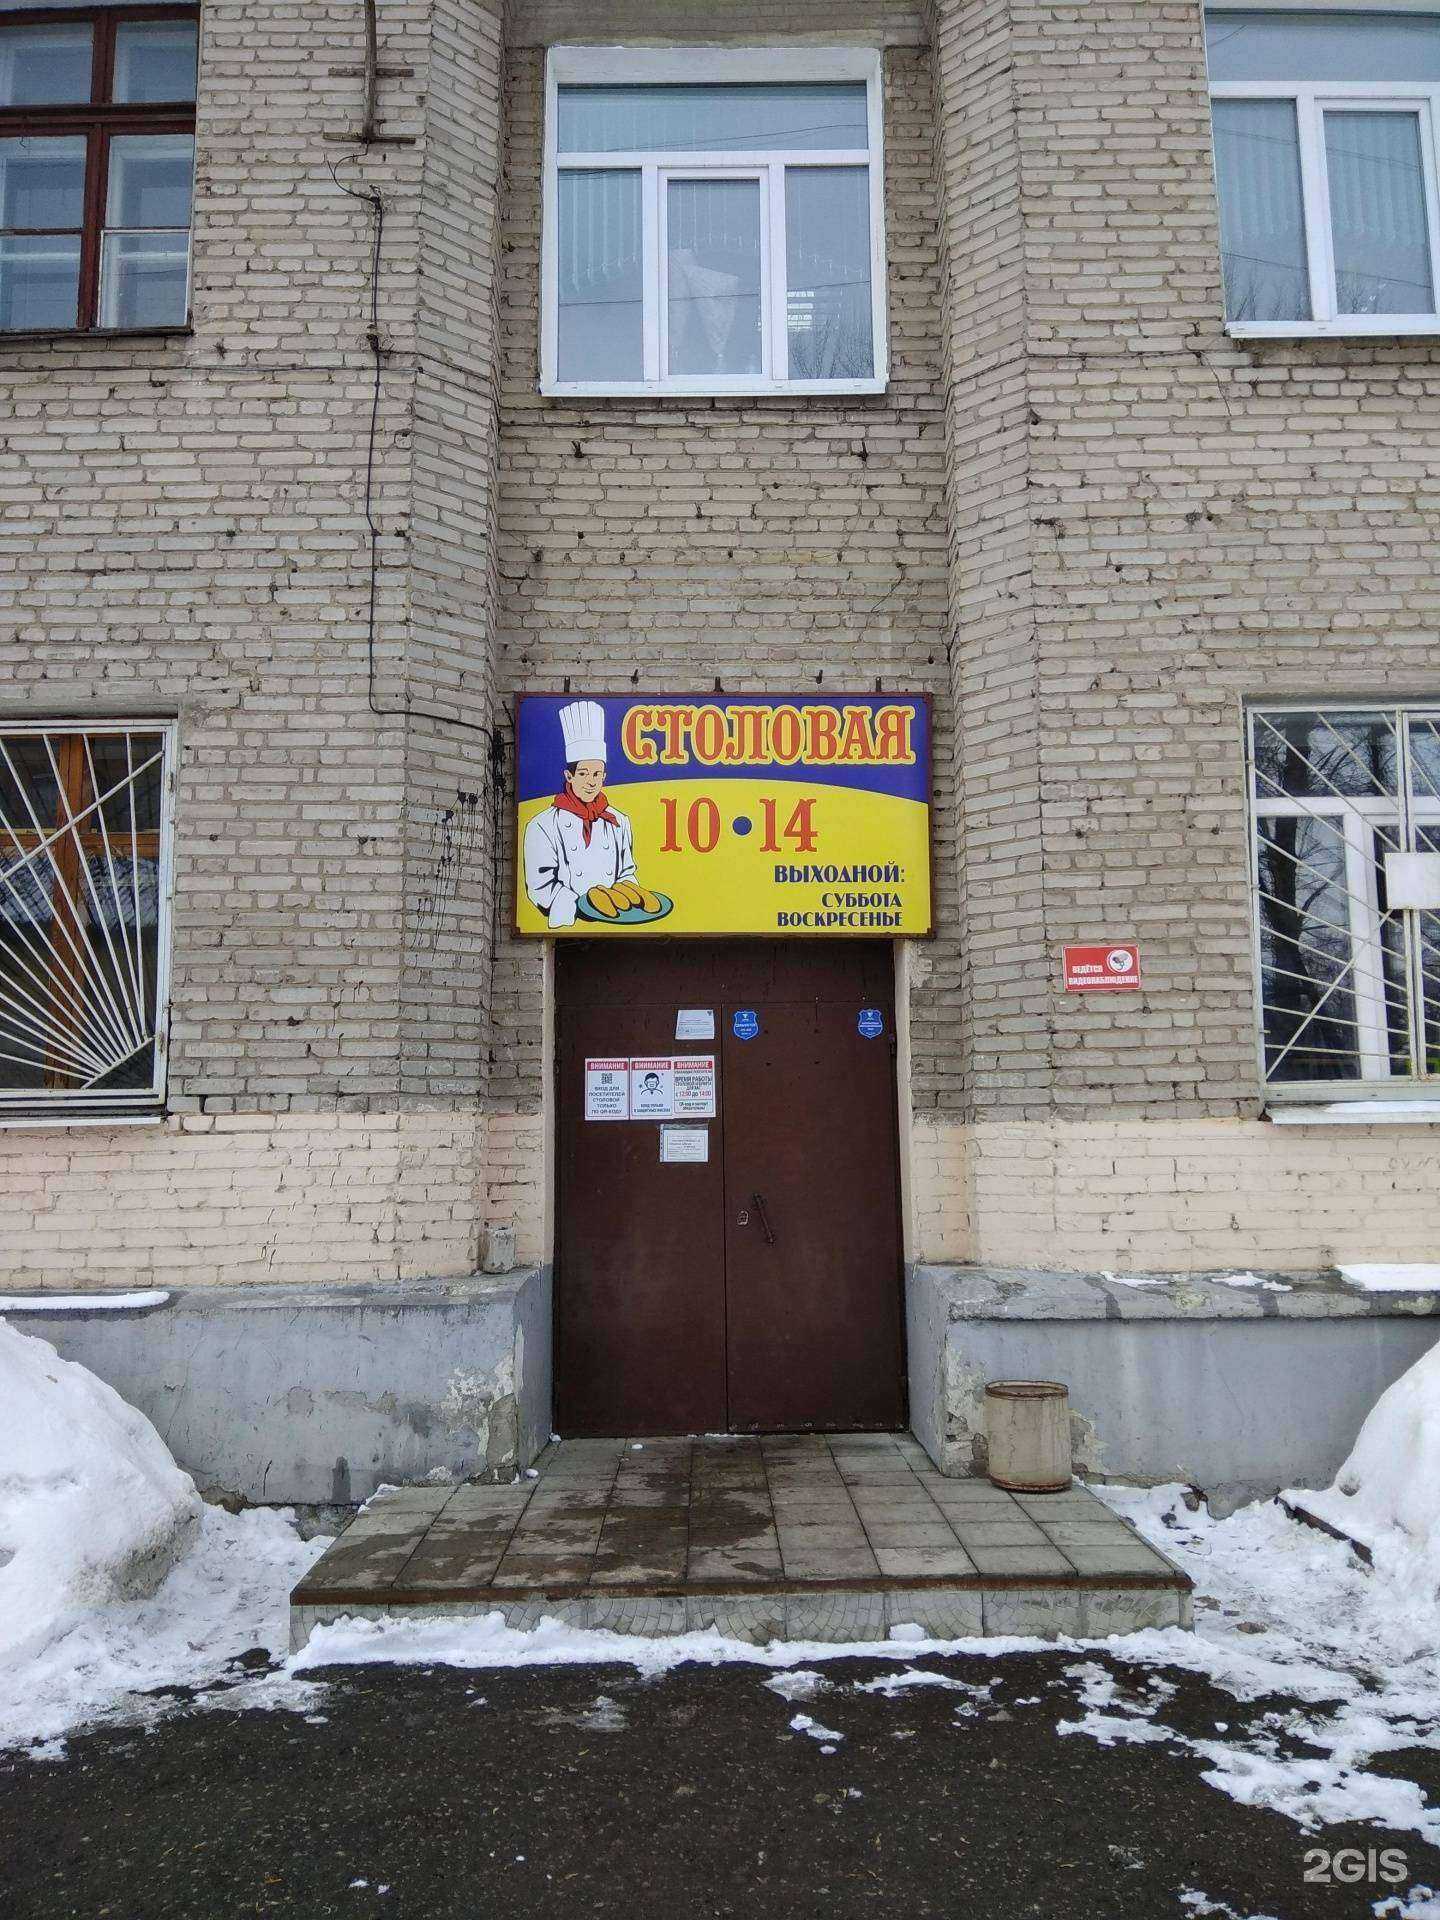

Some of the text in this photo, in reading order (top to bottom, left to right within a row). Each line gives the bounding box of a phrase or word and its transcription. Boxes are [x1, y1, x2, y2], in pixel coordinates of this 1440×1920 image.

[622, 705, 915, 764] СТОЛОВАЯ
[660, 797, 818, 853] 10 14
[774, 860, 905, 884] ВЫХОДНОЙ:
[821, 892, 903, 908] СУББОТА
[777, 911, 903, 927] ВОСКРЕСЕНЬЕ
[1068, 975, 1138, 986] ВИДЕОНАБЛЮДЕНИЕ
[590, 1062, 625, 1070] ВНИМАНИЕ
[634, 1061, 669, 1069] ВНИМАНИЕ
[676, 1061, 709, 1069] ВНИМАНИЕ
